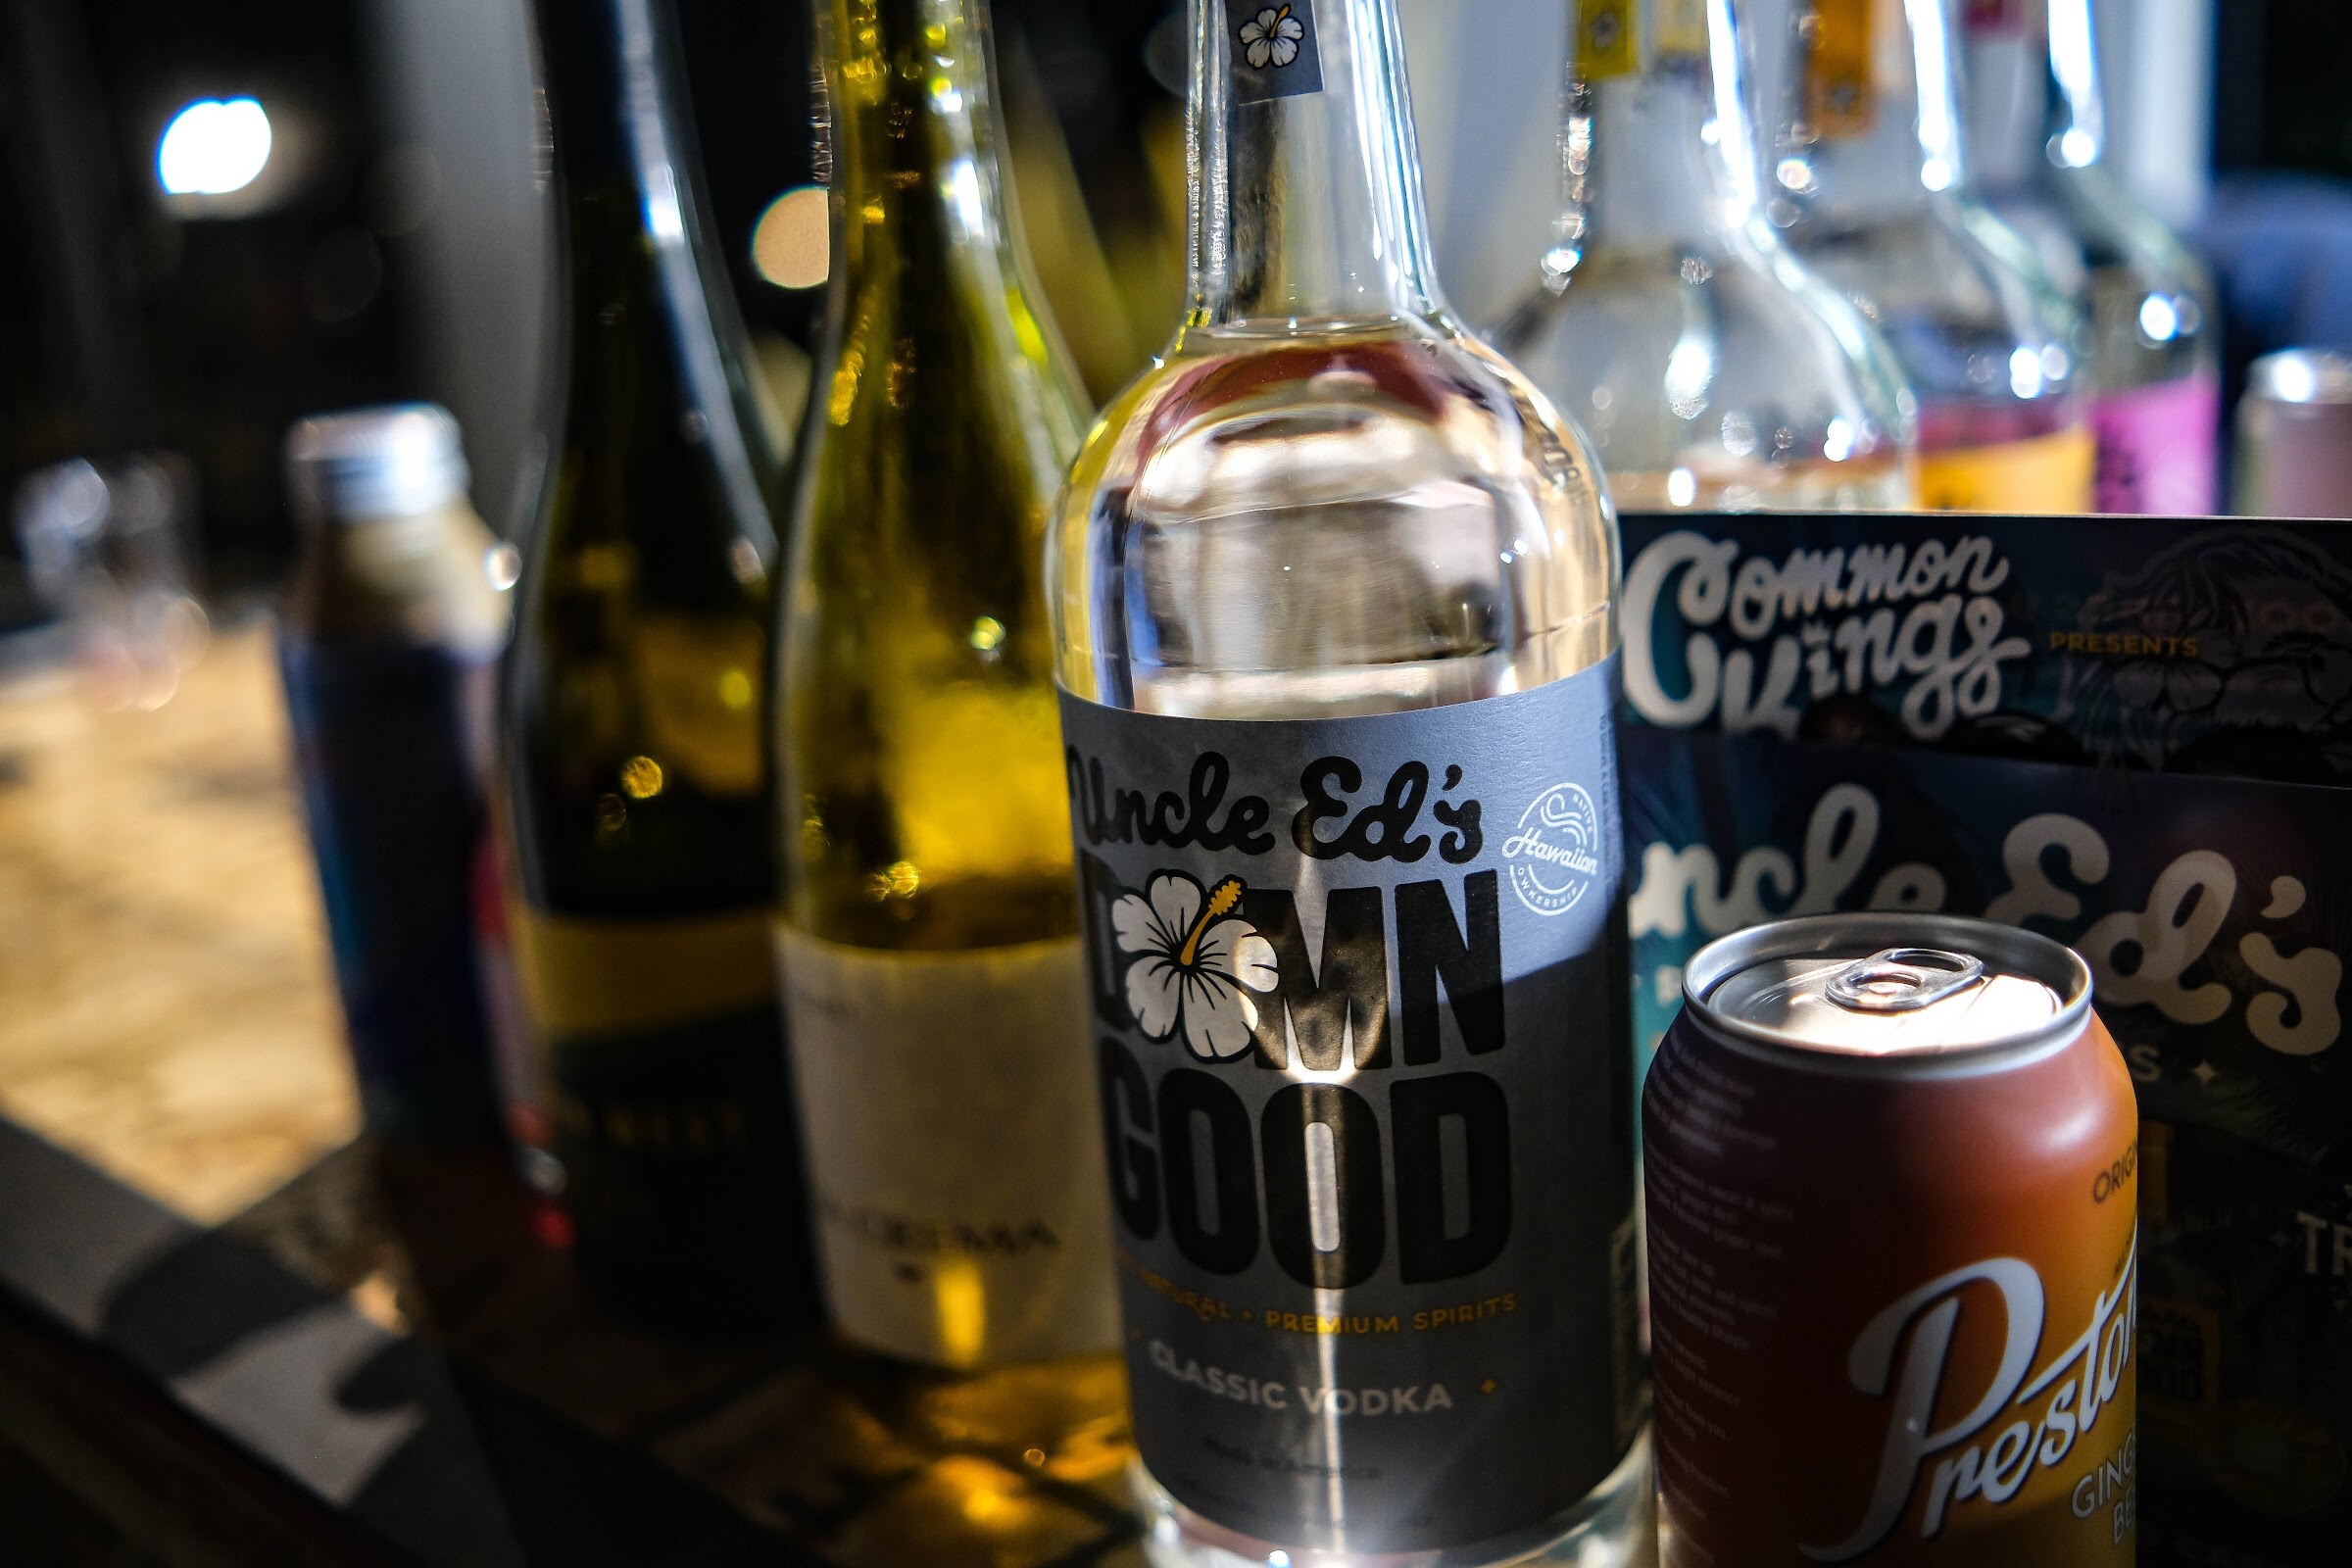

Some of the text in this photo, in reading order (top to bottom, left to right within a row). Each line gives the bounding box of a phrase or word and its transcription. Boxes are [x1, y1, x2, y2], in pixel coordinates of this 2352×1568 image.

[1620, 530, 2011, 728] Common
[2049, 630, 2200, 660] PRESENTS
[1066, 745, 1276, 856] Uncle
[1292, 755, 1484, 864] Ed's
[1501, 826, 1598, 876] Hawaiian
[1517, 866, 1578, 907] OWNERSHIP
[1628, 783, 1947, 939] ncle
[1982, 812, 2343, 1056] Ed's
[1080, 848, 1506, 1070] DMN
[1099, 1034, 1513, 1291] GOOD
[1266, 1309, 1400, 1336] PREMIUM
[1413, 1293, 1518, 1332] SPIRITS
[1148, 1339, 1453, 1417] CLASSIC VODKA
